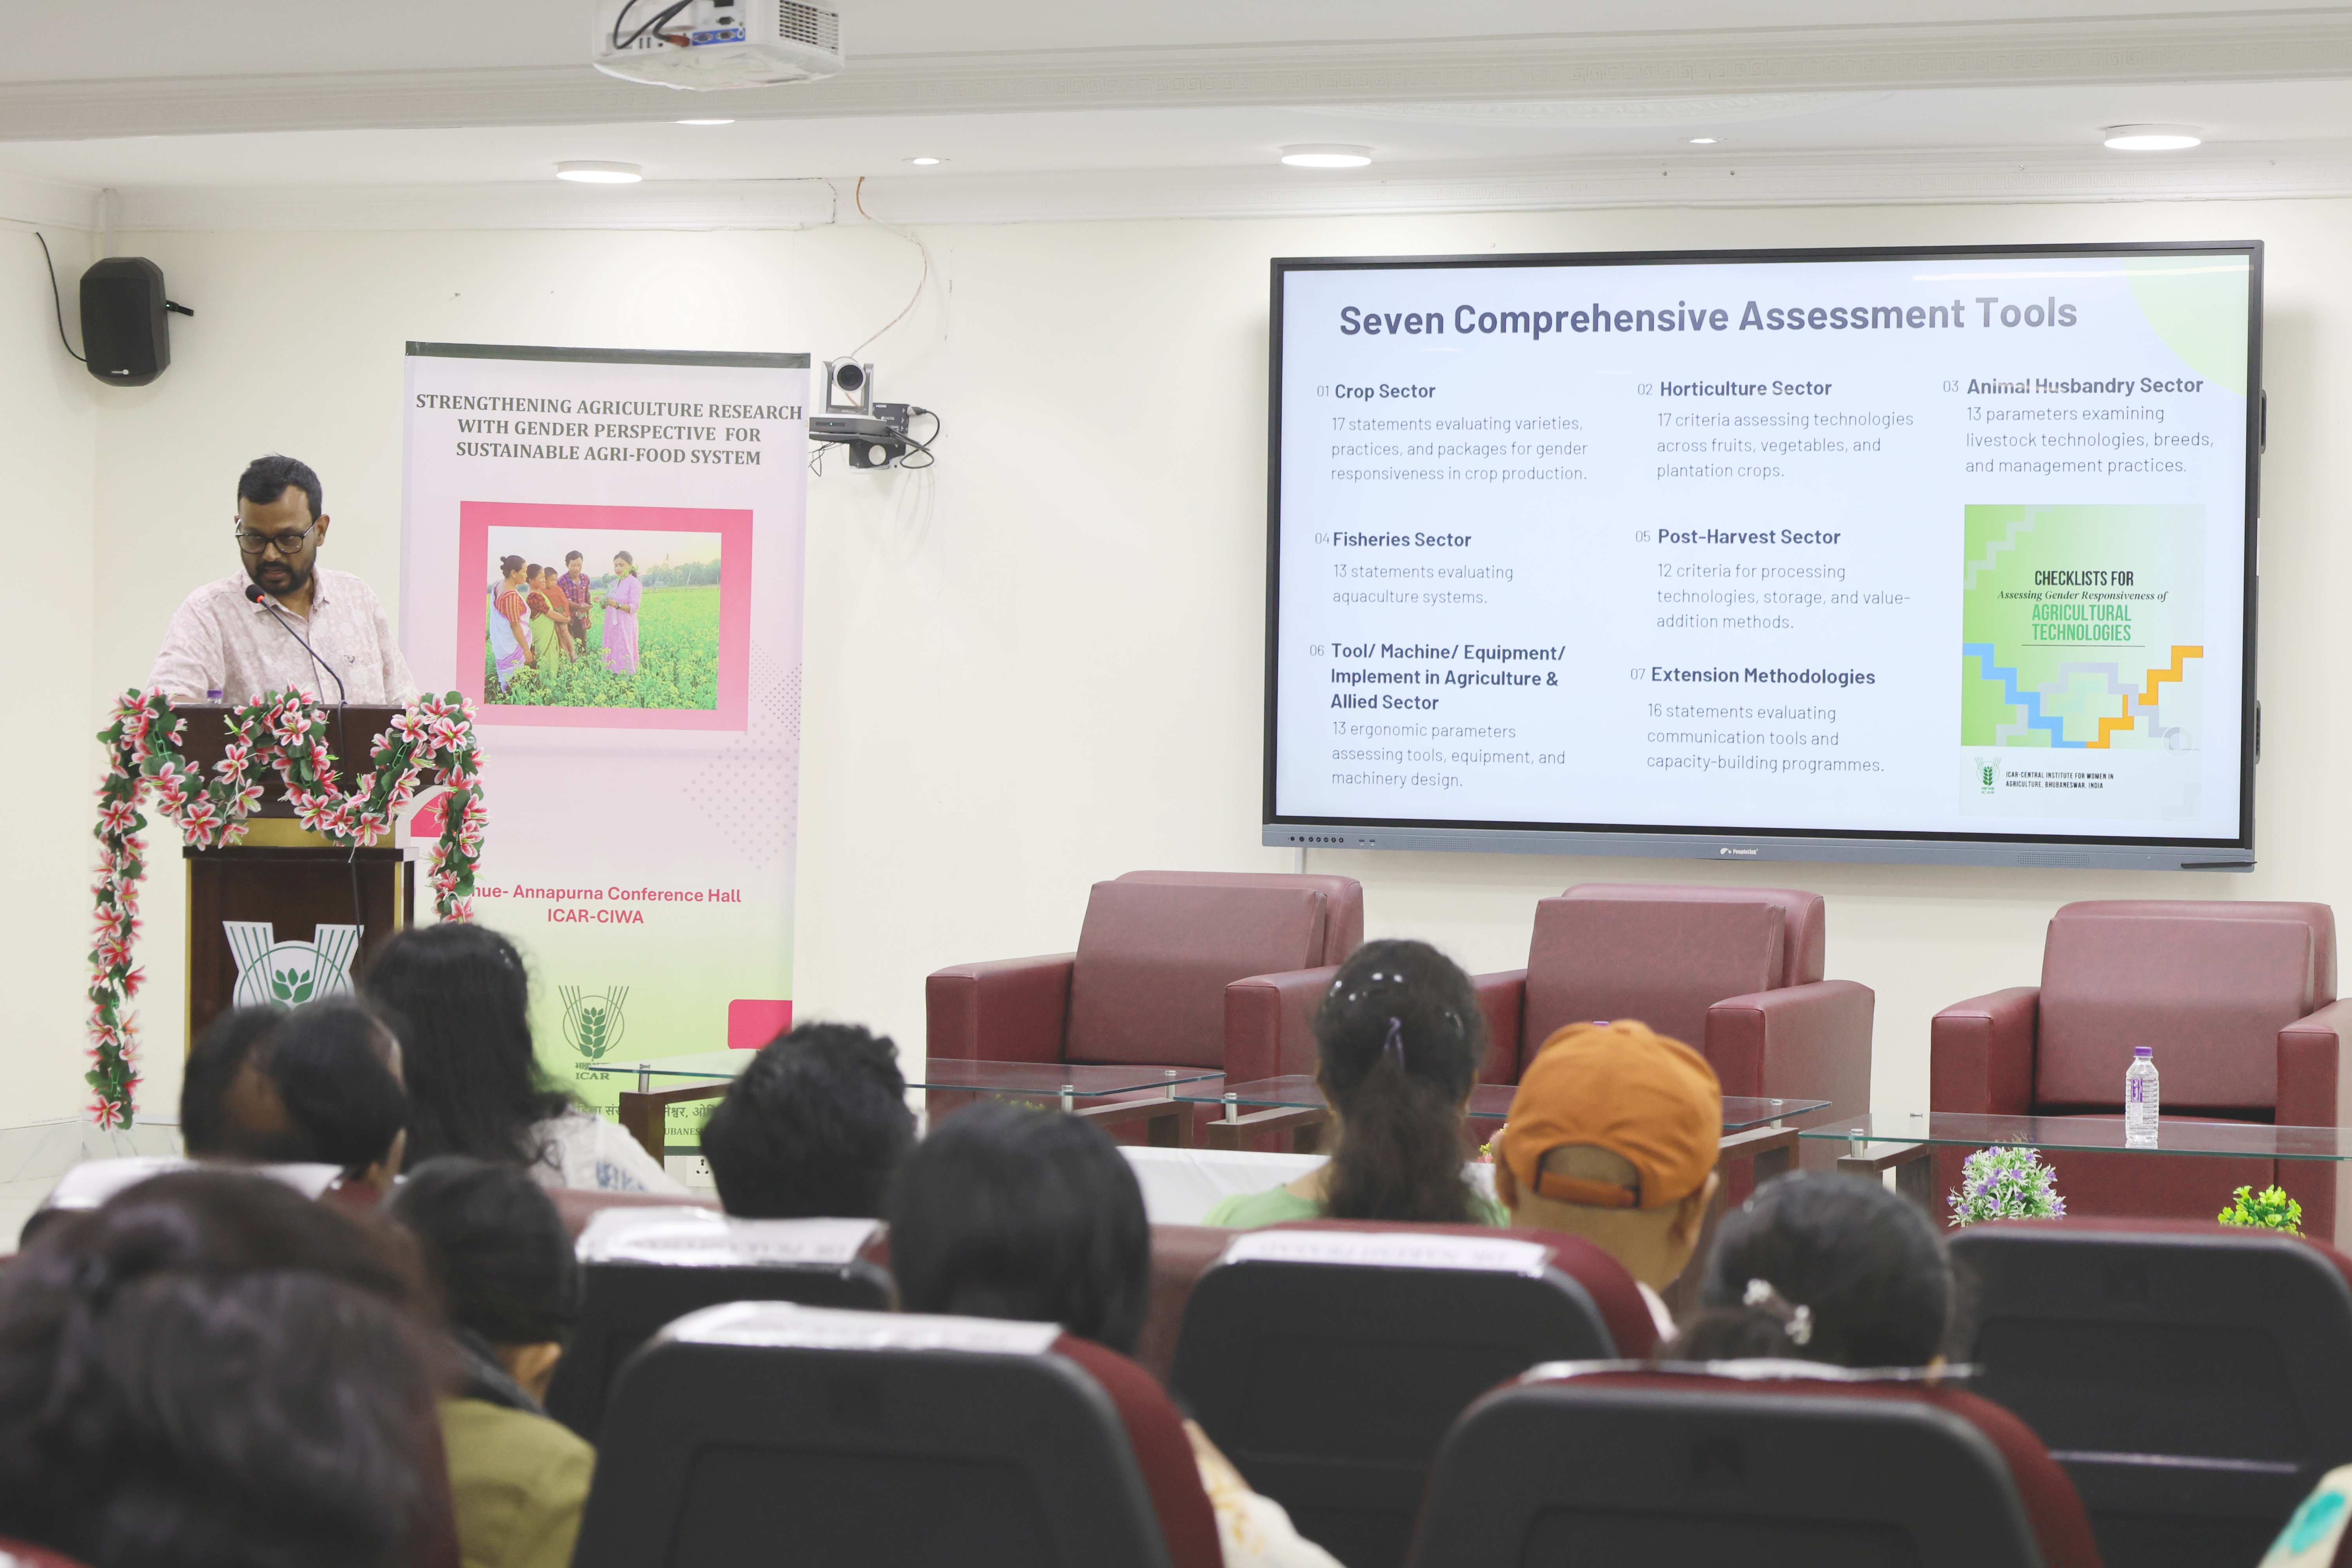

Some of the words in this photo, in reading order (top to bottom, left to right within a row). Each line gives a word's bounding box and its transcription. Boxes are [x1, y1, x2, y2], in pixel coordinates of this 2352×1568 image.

[1340, 306, 1444, 335] Seven
[1455, 300, 1729, 341] Comprehensive
[1739, 299, 1965, 330] Assessment
[1975, 296, 2077, 328] Tools
[1317, 385, 1329, 397] 01
[1335, 384, 1374, 402] Crop
[1379, 384, 1436, 398] Sector
[1638, 383, 1653, 395] 02
[1661, 381, 1767, 396] Horticulture
[1772, 380, 1832, 396] Sector
[1943, 380, 1959, 392] 03
[1967, 378, 2030, 394] Animal
[2036, 377, 2135, 397] Husbandry
[2140, 377, 2203, 393] Sector
[416, 394, 572, 414] STRENGTHENING
[576, 400, 703, 417] AGRICULTURE
[708, 404, 802, 420] RESEARCH
[1967, 407, 1981, 421] 13
[1987, 408, 2077, 425] parameters
[2083, 406, 2164, 423] examining
[1332, 417, 1345, 431] 17
[1349, 418, 1431, 431] statements
[1436, 417, 1510, 434] evaluating
[1515, 416, 1582, 431] varieties,
[1658, 413, 1671, 427] 17
[1676, 413, 1730, 426] criteria
[1734, 412, 1809, 430] assessing
[1813, 412, 1913, 429] technologies
[457, 419, 509, 434] WITH
[514, 421, 590, 437] GENDER
[594, 424, 716, 441] PERSPECTIVE
[725, 428, 761, 442] FOR
[1332, 442, 1403, 459] practices,
[1407, 442, 1433, 455] and
[1438, 442, 1506, 459] packages
[1511, 441, 1532, 455] for
[1536, 441, 1588, 459] gender
[1657, 442, 1707, 452] across
[1711, 438, 1755, 453] fruits,
[1761, 438, 1848, 455] vegetables,
[1853, 437, 1880, 451] and
[1967, 432, 2036, 447] livestock
[2041, 432, 2148, 450] technologies,
[2154, 432, 2213, 447] breeds,
[456, 442, 579, 460] SUSTAINABLE
[584, 446, 686, 463] AGRI-FOOD
[691, 450, 761, 465] SYSTEM
[1332, 466, 1444, 483] responsiveness
[1449, 466, 1460, 480] in
[1465, 470, 1497, 483] crop
[1503, 466, 1586, 483] production.
[1657, 463, 1733, 481] plantation
[1738, 466, 1784, 481] crops.
[1966, 458, 1993, 472] and
[1999, 459, 2103, 476] management
[2108, 458, 2186, 476] practices.
[1315, 533, 1330, 544] 04
[1334, 532, 1410, 546] Fisheries
[1415, 532, 1472, 547] Sector
[1636, 531, 1650, 542] 05
[1659, 529, 1776, 544] Post-Harvest
[1781, 529, 1841, 544] Sector
[1334, 564, 1347, 577] 13
[1351, 566, 1434, 578] statements
[1438, 565, 1513, 582] evaluating
[1658, 563, 1672, 577] 12
[1677, 563, 1731, 577] criteria
[1735, 564, 1757, 578] for
[1762, 564, 1845, 582] processing
[2035, 570, 2107, 586] CHECKLISTS
[2111, 571, 2134, 586] FOR
[1333, 589, 1418, 606] aquaculture
[1423, 591, 1487, 607] systems.
[1657, 589, 1759, 607] technologies,
[1764, 591, 1826, 607] storage,
[1831, 590, 1858, 604] and
[1863, 590, 1910, 604] value-
[1997, 590, 2042, 602] Assessing
[2045, 591, 2080, 599] Gender
[2082, 591, 2155, 602] Responsiveness
[2157, 591, 2168, 602] of
[1657, 614, 1718, 628] addition
[1723, 614, 1793, 629] methods.
[2032, 604, 2132, 621] AGRICULTURAL
[2032, 624, 2131, 641] TECHNOLOGIES
[1310, 644, 1324, 656] 06
[1331, 643, 1376, 658] Tool/
[1381, 644, 1459, 659] Machine/
[1464, 644, 1566, 663] Equipment/
[1332, 668, 1421, 687] Implement
[1426, 669, 1439, 684] in
[1444, 670, 1541, 688] Agriculture
[1546, 671, 1558, 686] &
[1631, 668, 1646, 680] 07
[1652, 667, 1739, 682] Extension
[1744, 668, 1875, 688] Methodologies
[1330, 693, 1377, 709] Allied
[1382, 695, 1439, 710] Sector
[1648, 703, 1662, 717] 16
[1666, 705, 1753, 719] statements
[1758, 705, 1836, 723] evaluating
[1333, 721, 1346, 735] 13
[1350, 723, 1427, 739] ergonomic
[1432, 725, 1515, 740] parameters
[1648, 730, 1764, 744] communication
[1769, 731, 1807, 745] tools
[1811, 732, 1838, 746] and
[1332, 747, 1403, 764] assessing
[1407, 748, 1446, 763] tools,
[1452, 749, 1534, 766] equipment,
[1539, 751, 1565, 764] and
[1647, 754, 1777, 773] capacity-building
[1783, 760, 1884, 774] programmes.
[1332, 771, 1407, 789] machinery
[1411, 772, 1463, 790] design.
[472, 887, 508, 897] nue-
[513, 884, 603, 902] Annapurna
[608, 886, 704, 902] Conference
[708, 889, 741, 902] Hall
[548, 908, 644, 924] ICAR-CIWA
